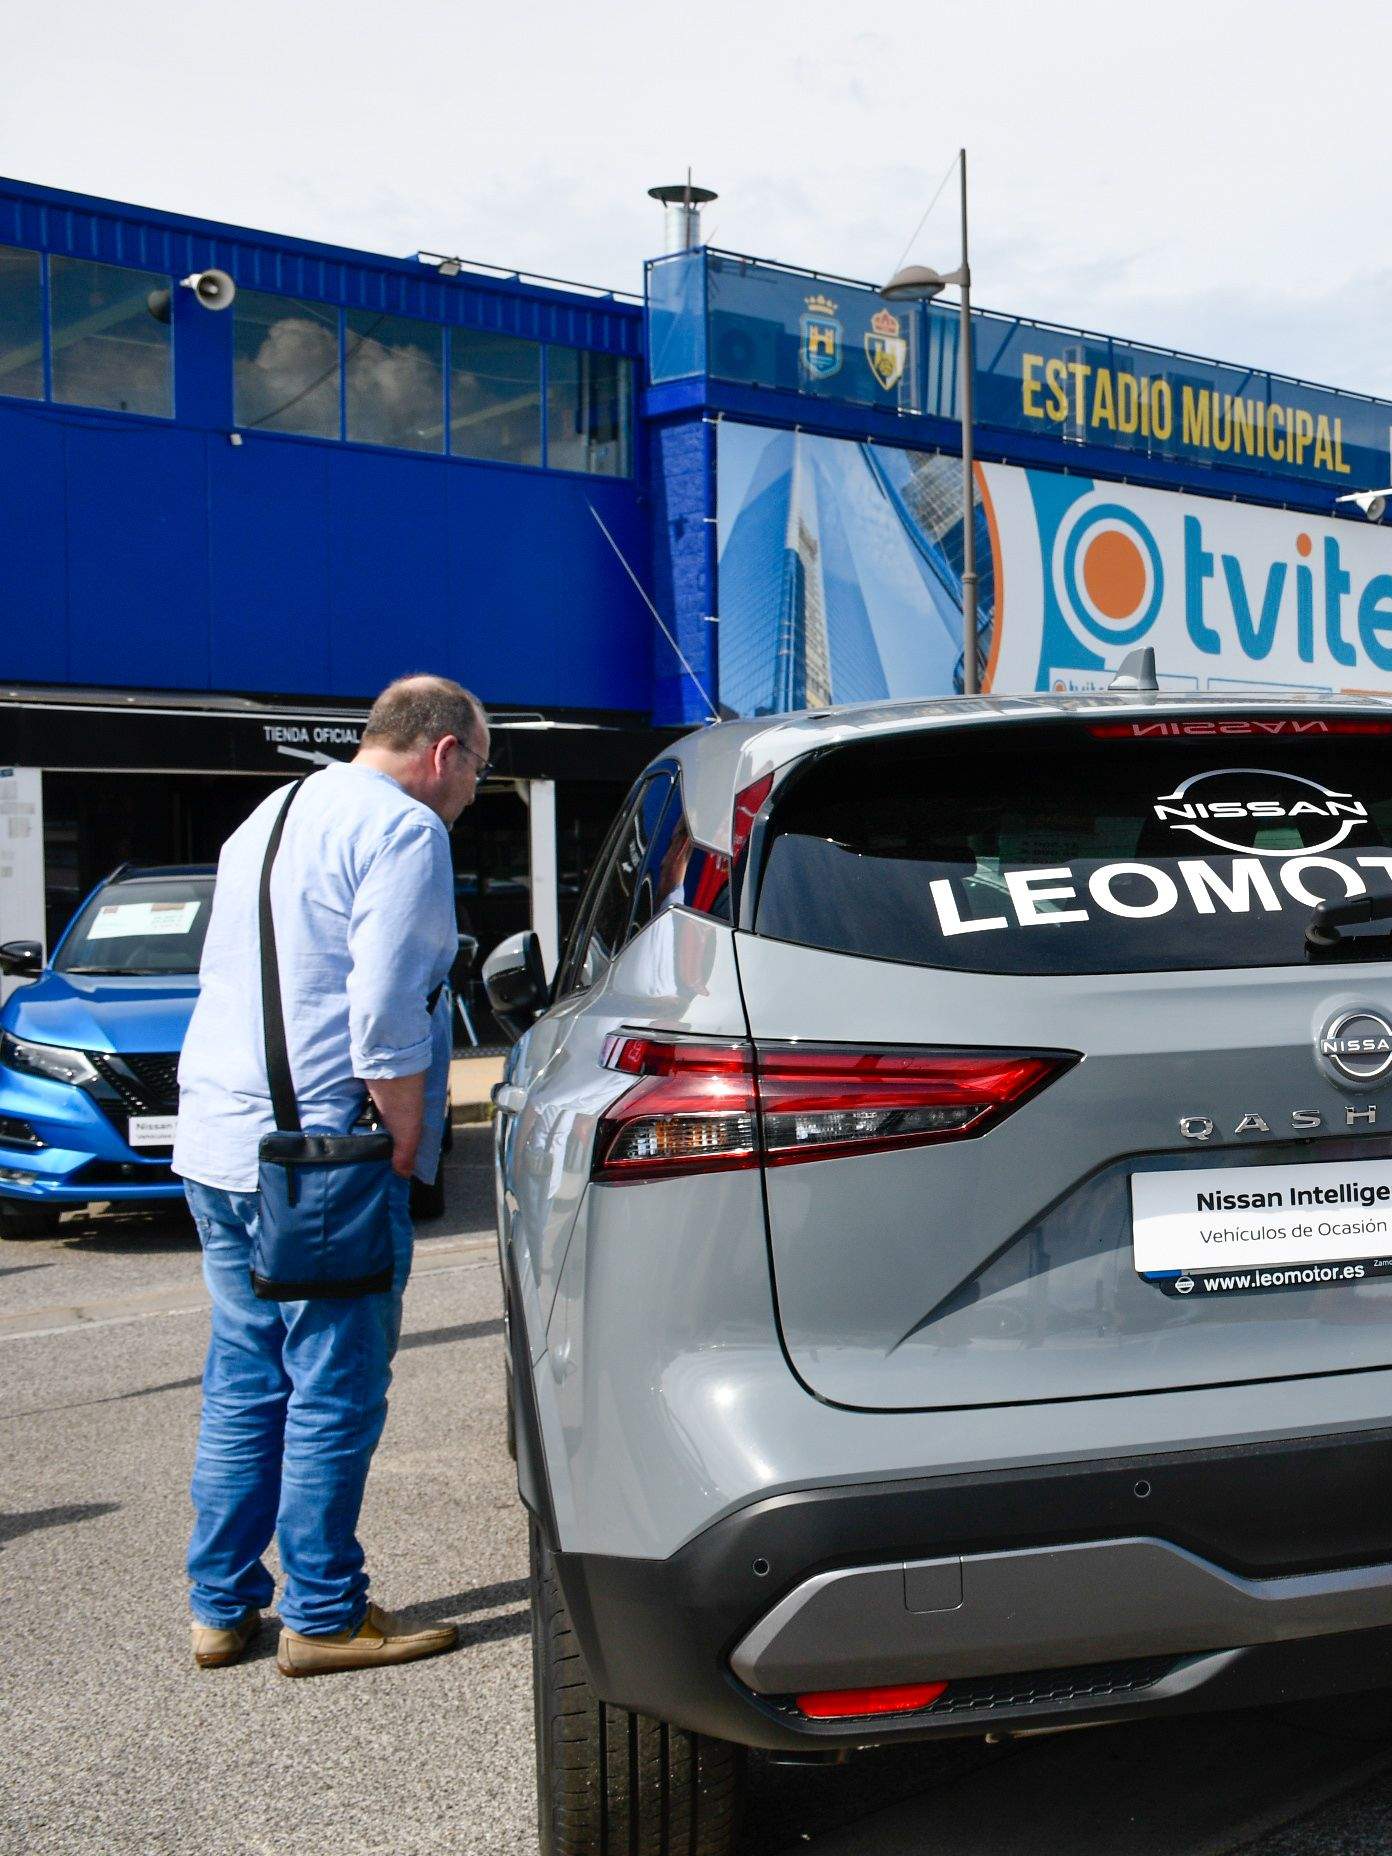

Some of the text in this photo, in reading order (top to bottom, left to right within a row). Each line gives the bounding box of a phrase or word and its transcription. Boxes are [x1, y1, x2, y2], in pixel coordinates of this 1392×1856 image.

[1022, 352, 1173, 441] ESTADIO
[1182, 385, 1352, 474] MUNICIPAL
[263, 726, 361, 744] TIENDA OFICIAL
[1152, 801, 1369, 821] NISSAN
[1197, 1190, 1283, 1212] Nissan
[1199, 1226, 1287, 1244] Vehículos
[1291, 1223, 1313, 1238] de
[1318, 1218, 1387, 1236] Ocasión
[1203, 1264, 1365, 1292] www.leomotor.es
